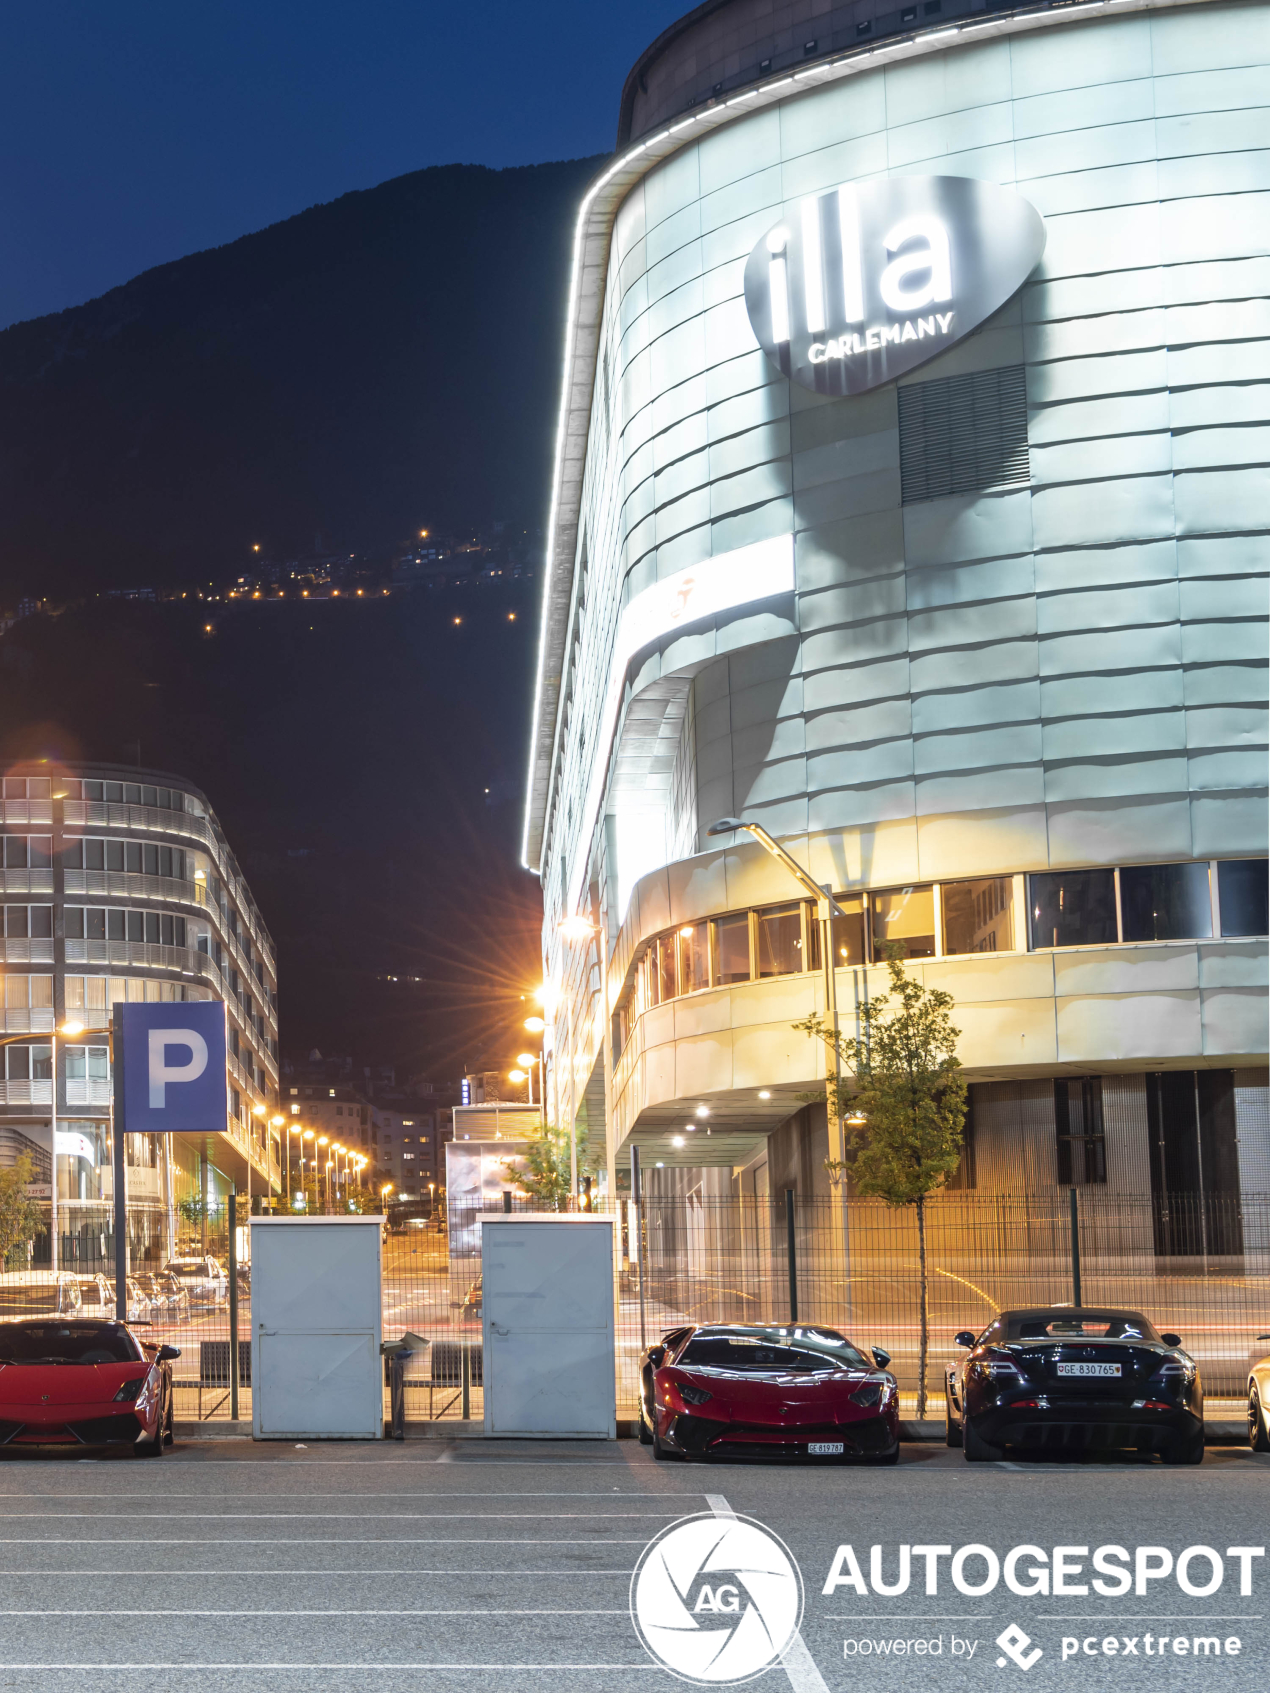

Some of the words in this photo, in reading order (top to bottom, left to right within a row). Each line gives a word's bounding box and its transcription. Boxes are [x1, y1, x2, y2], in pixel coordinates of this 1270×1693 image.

[766, 181, 953, 344] illa
[808, 311, 954, 364] CARLEMANY
[148, 1028, 209, 1109] P
